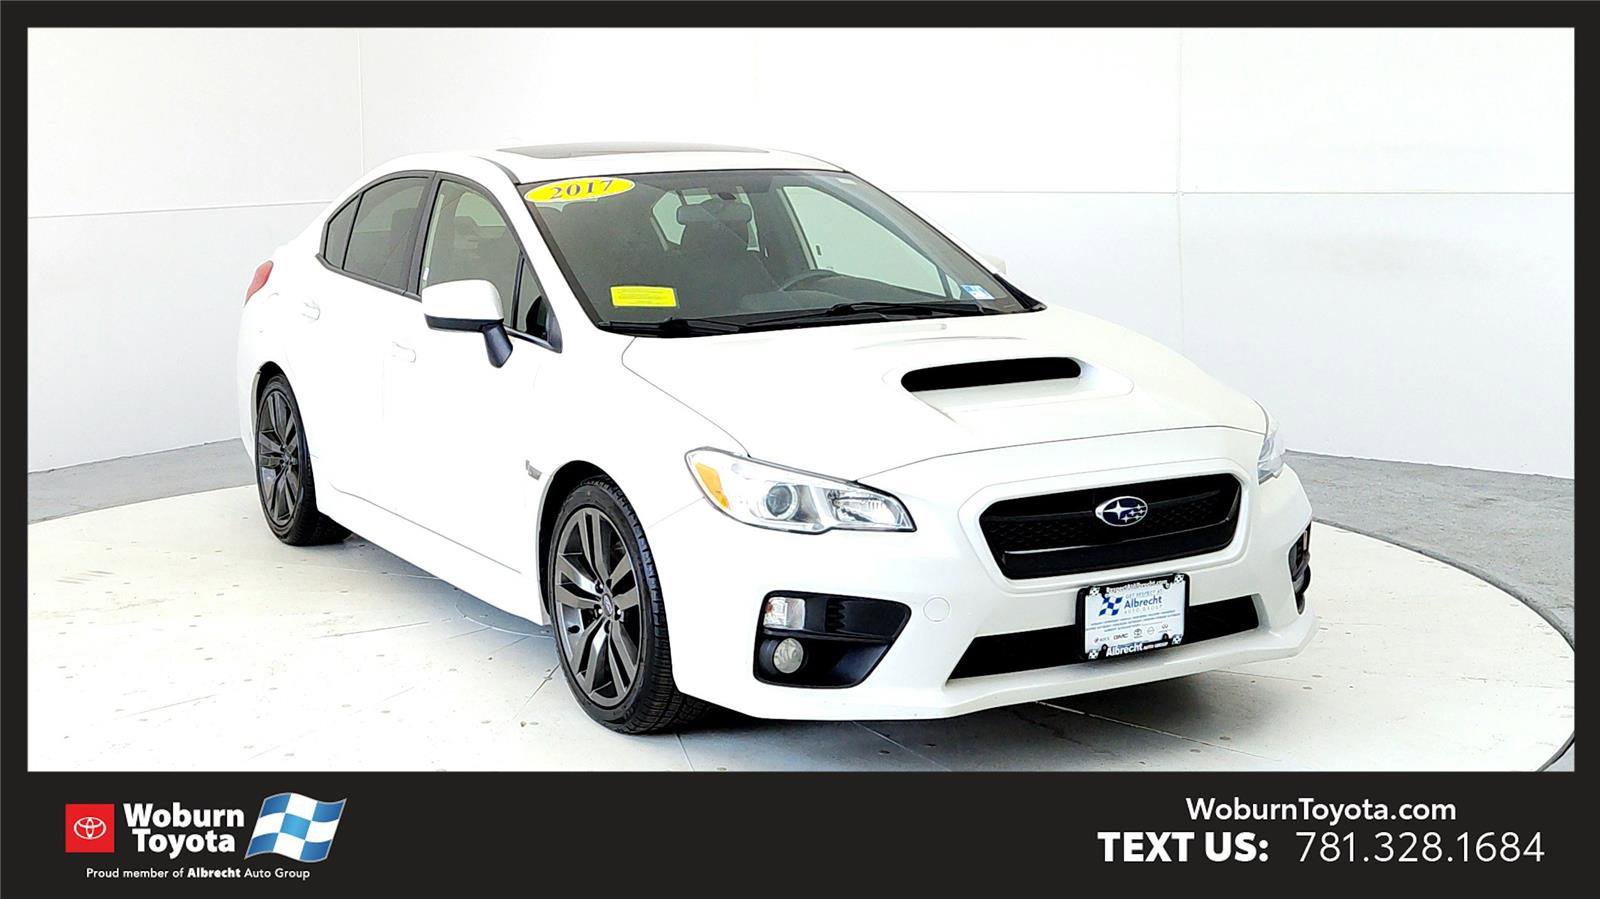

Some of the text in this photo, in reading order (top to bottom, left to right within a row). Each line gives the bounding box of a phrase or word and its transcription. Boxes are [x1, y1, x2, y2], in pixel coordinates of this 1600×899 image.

[550, 180, 613, 200] 2017
[1124, 595, 1162, 609] Albrecht
[1106, 643, 1143, 657] Albrecht
